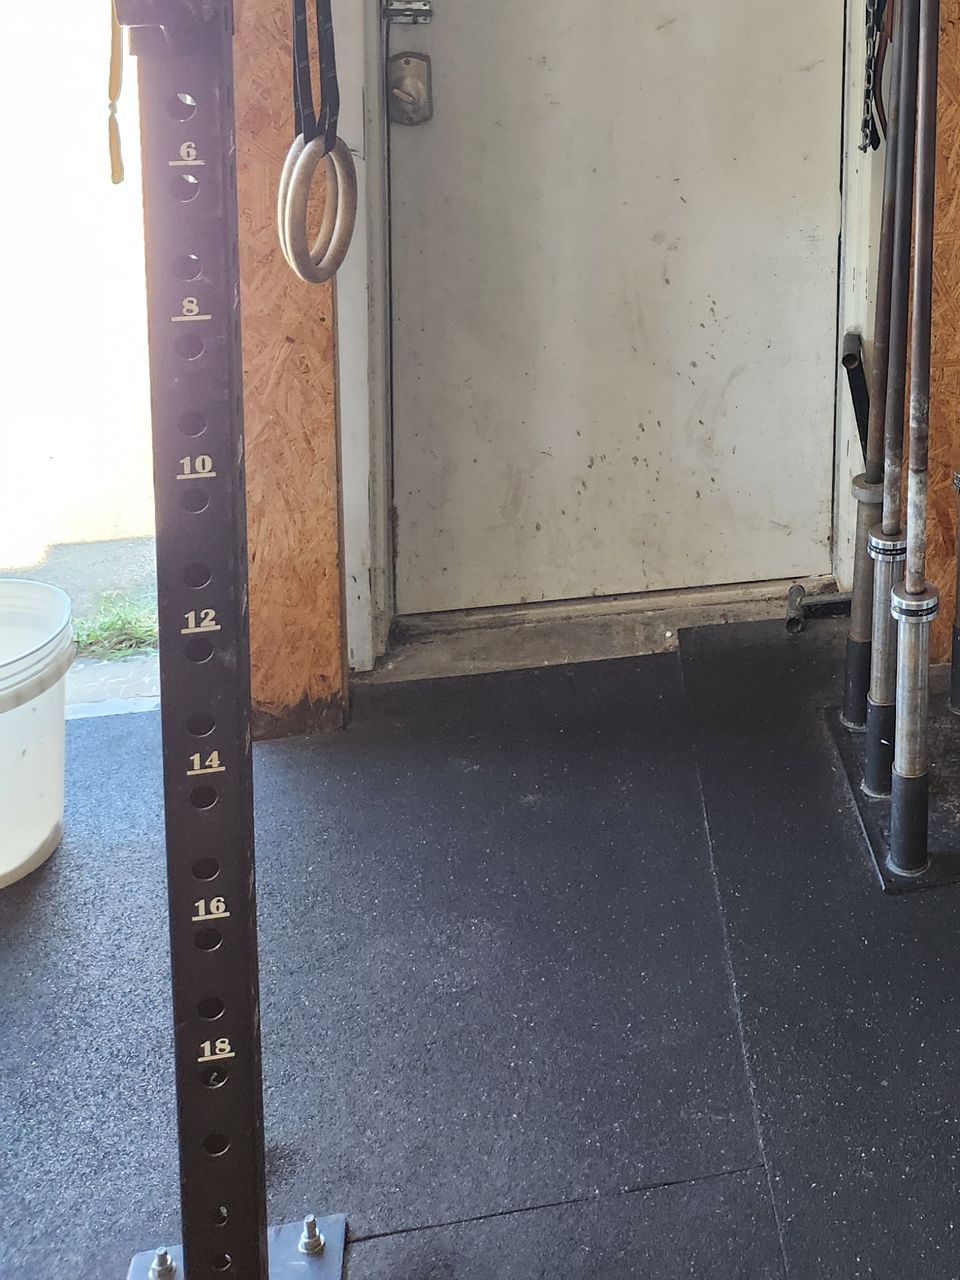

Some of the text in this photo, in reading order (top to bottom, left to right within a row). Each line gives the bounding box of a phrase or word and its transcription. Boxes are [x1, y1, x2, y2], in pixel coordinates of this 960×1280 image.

[179, 142, 197, 161] 6
[182, 297, 199, 316] 8
[178, 454, 213, 476] 10
[184, 608, 217, 629] 12
[189, 750, 221, 771] 14
[193, 896, 226, 916] 16
[199, 1037, 232, 1058] 18
